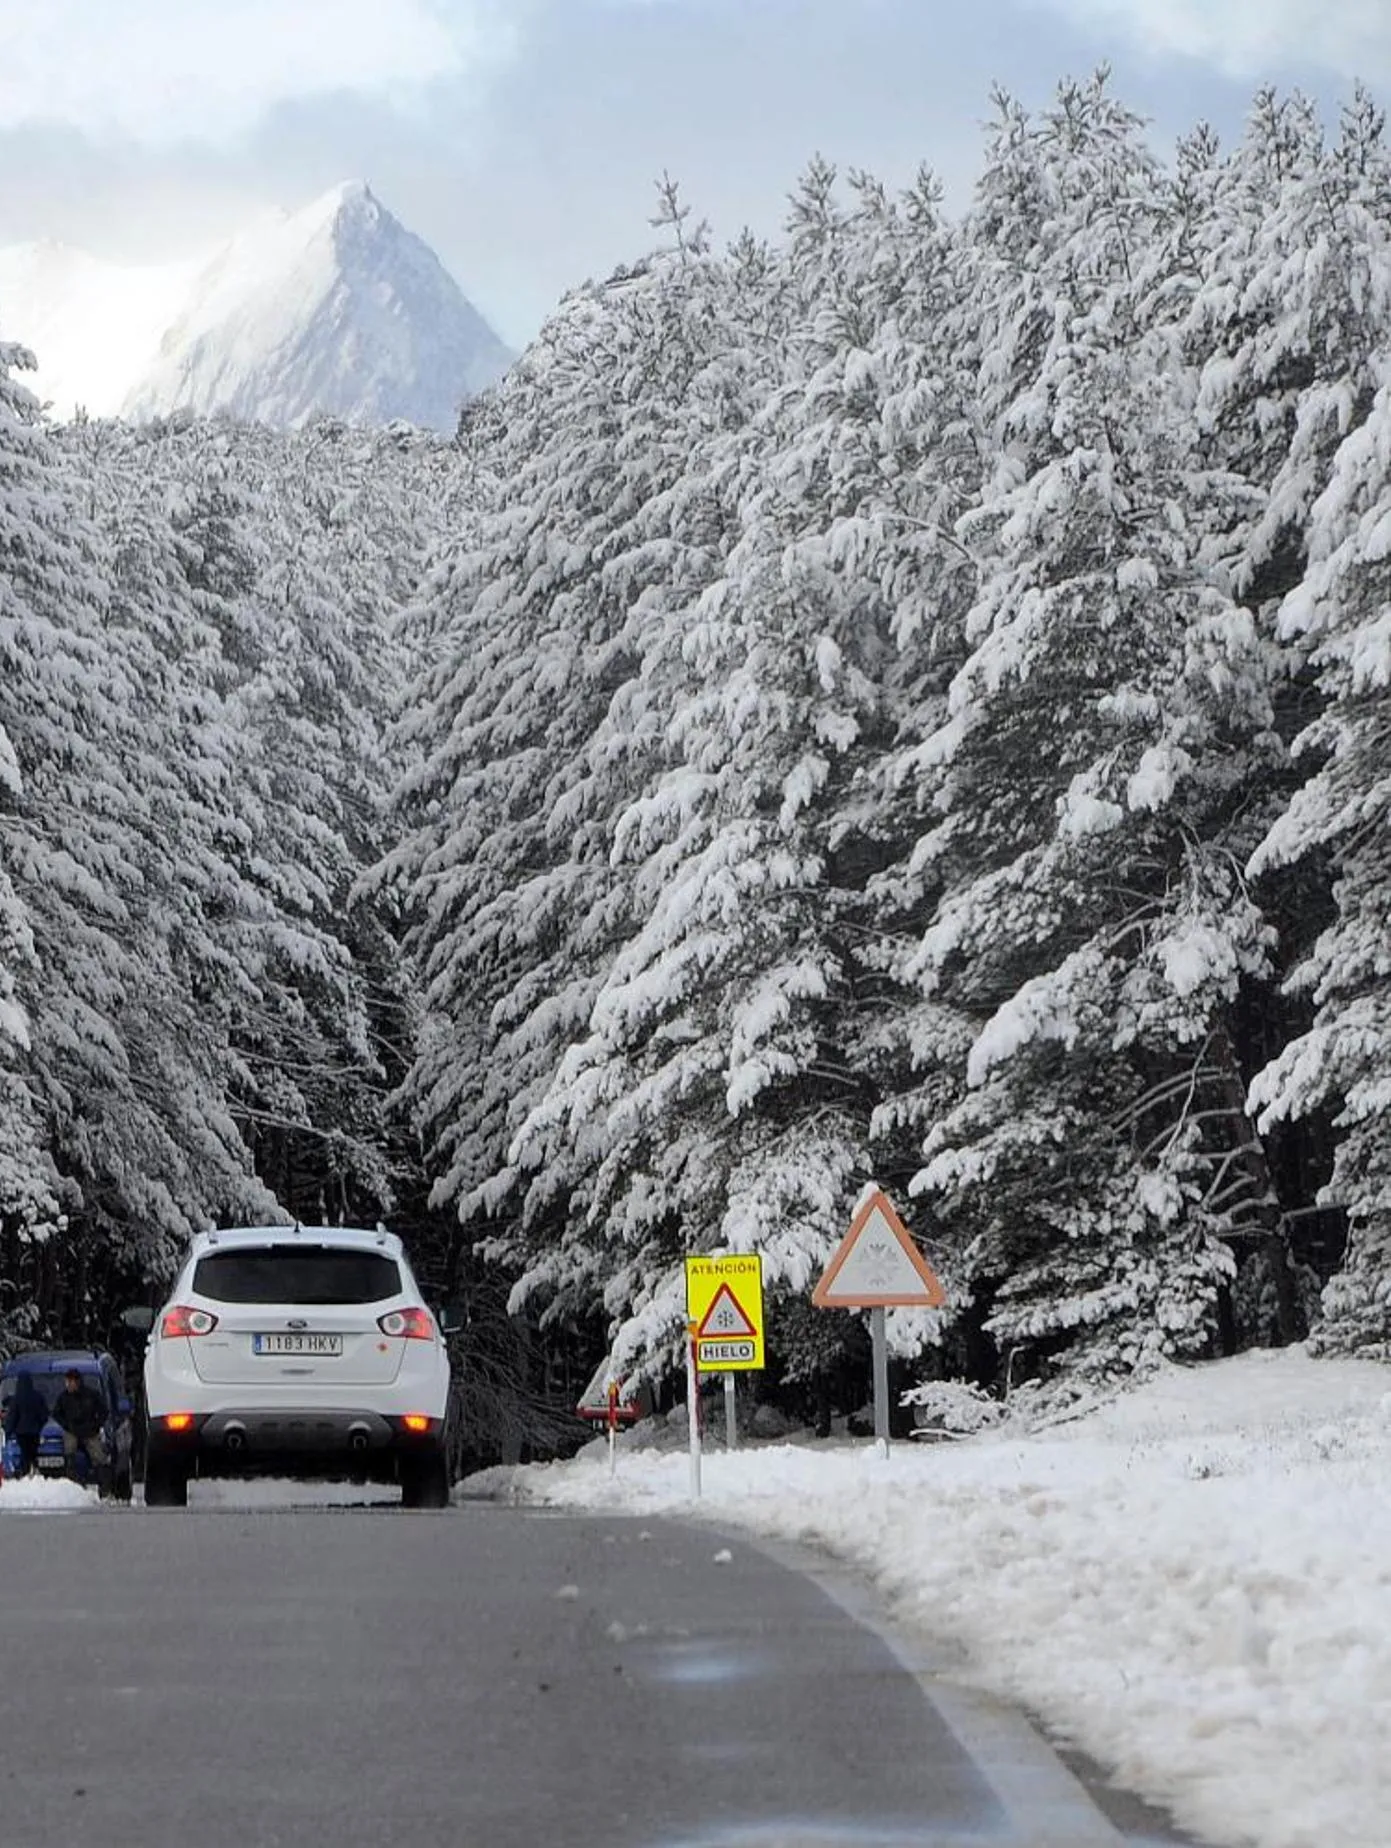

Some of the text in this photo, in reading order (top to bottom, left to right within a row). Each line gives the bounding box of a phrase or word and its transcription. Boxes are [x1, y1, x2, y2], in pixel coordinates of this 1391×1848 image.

[691, 1262, 756, 1275] ATENCIÓN
[267, 1335, 338, 1351] 1183 HKV
[703, 1345, 750, 1358] HIELO
